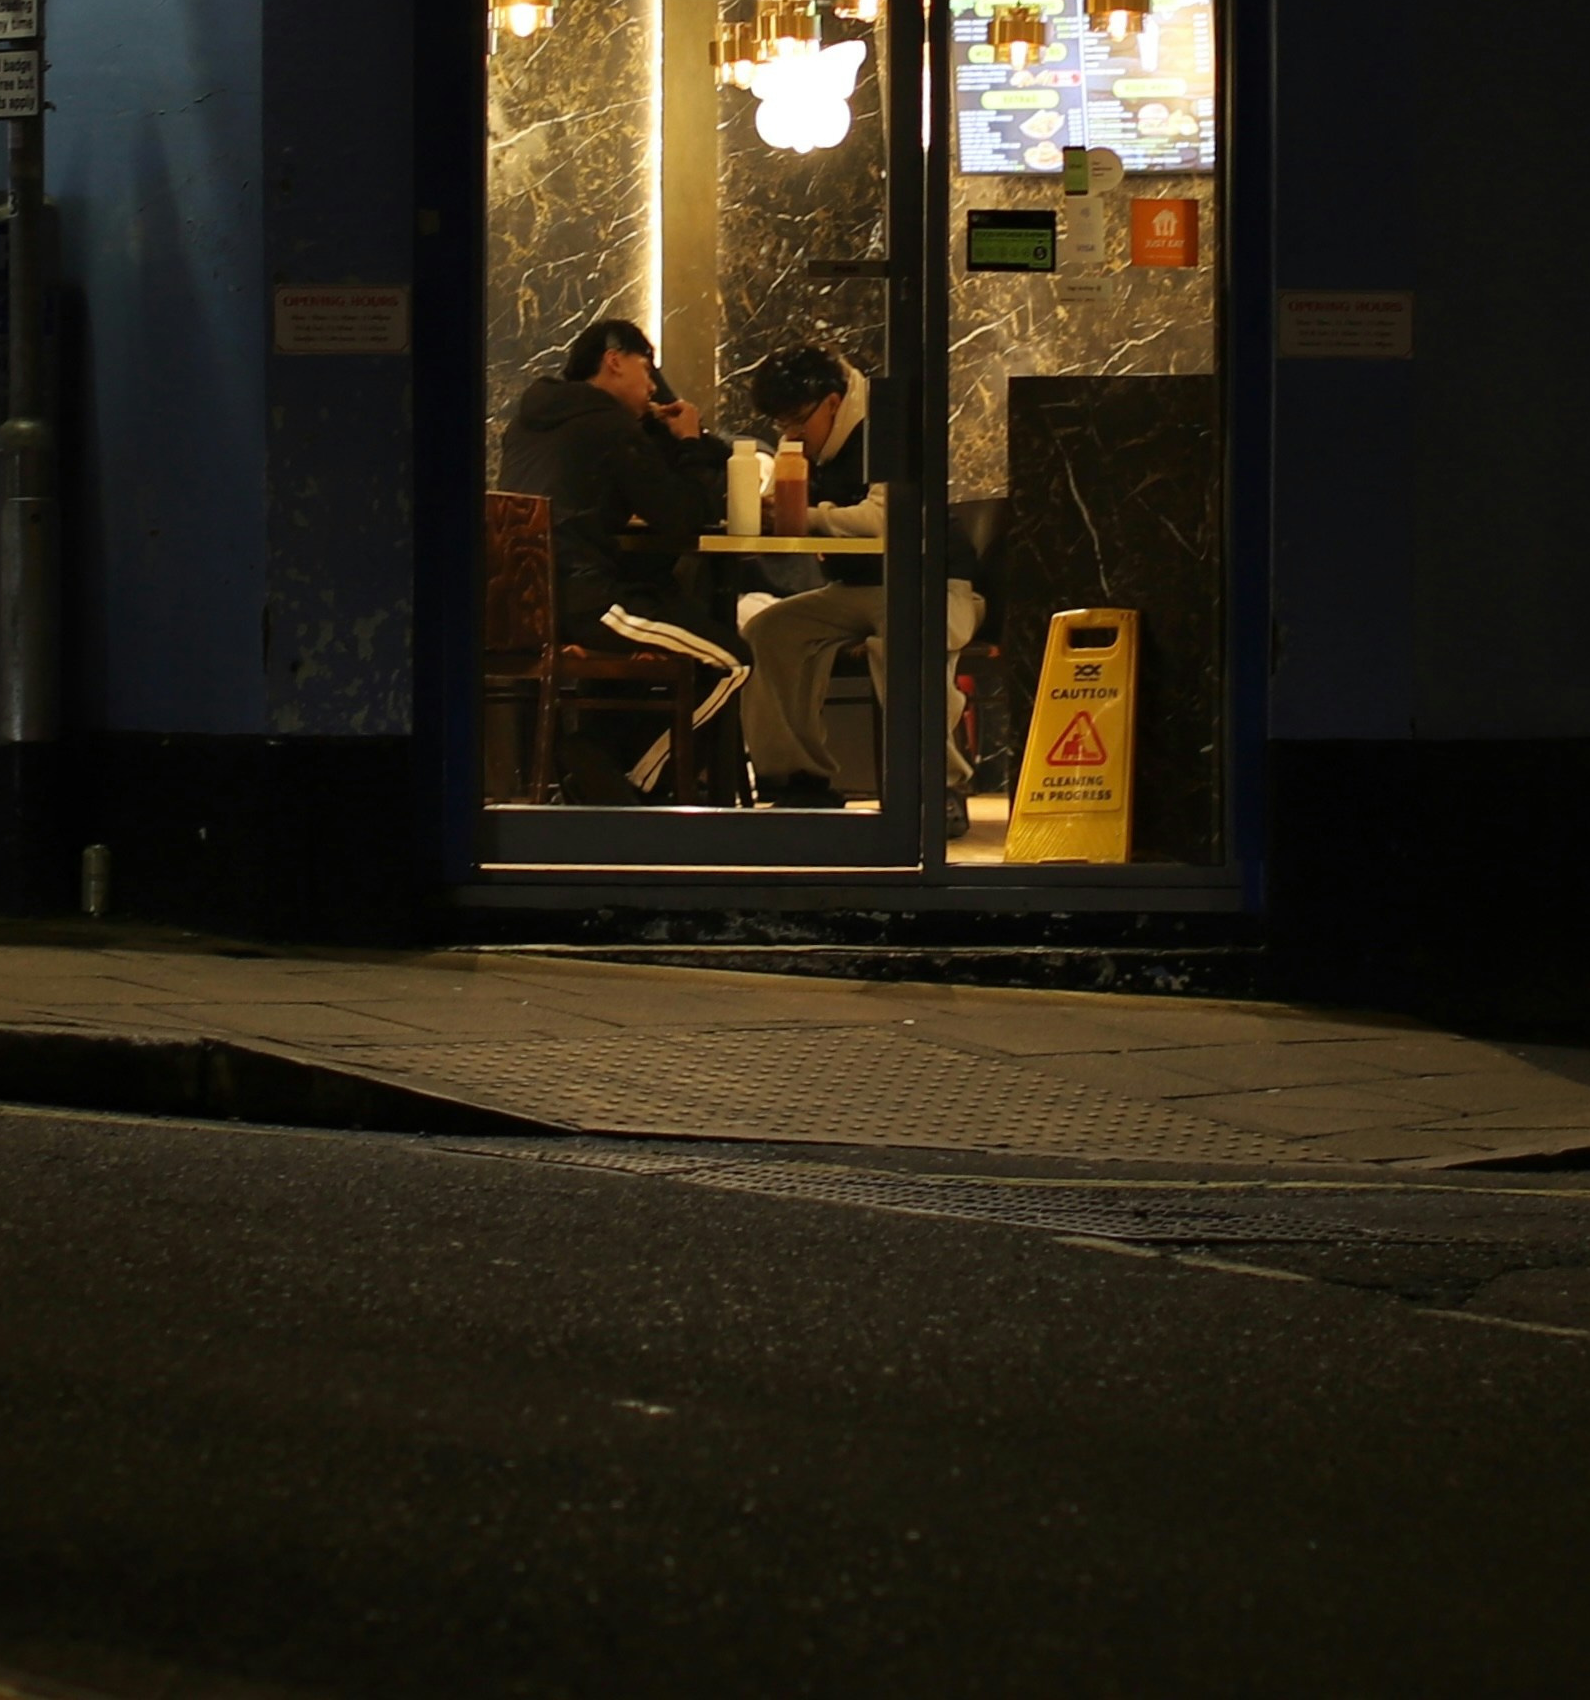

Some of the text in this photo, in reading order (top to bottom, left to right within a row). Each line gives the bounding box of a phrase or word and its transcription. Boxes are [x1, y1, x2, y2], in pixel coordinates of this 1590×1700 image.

[11, 18, 34, 30] time
[3, 58, 32, 74] badge
[1144, 239, 1186, 248] JUST EAT
[1050, 687, 1119, 700] CAUTION
[1041, 775, 1104, 788] CLEANING
[1029, 789, 1112, 803] IN PROGRESS
